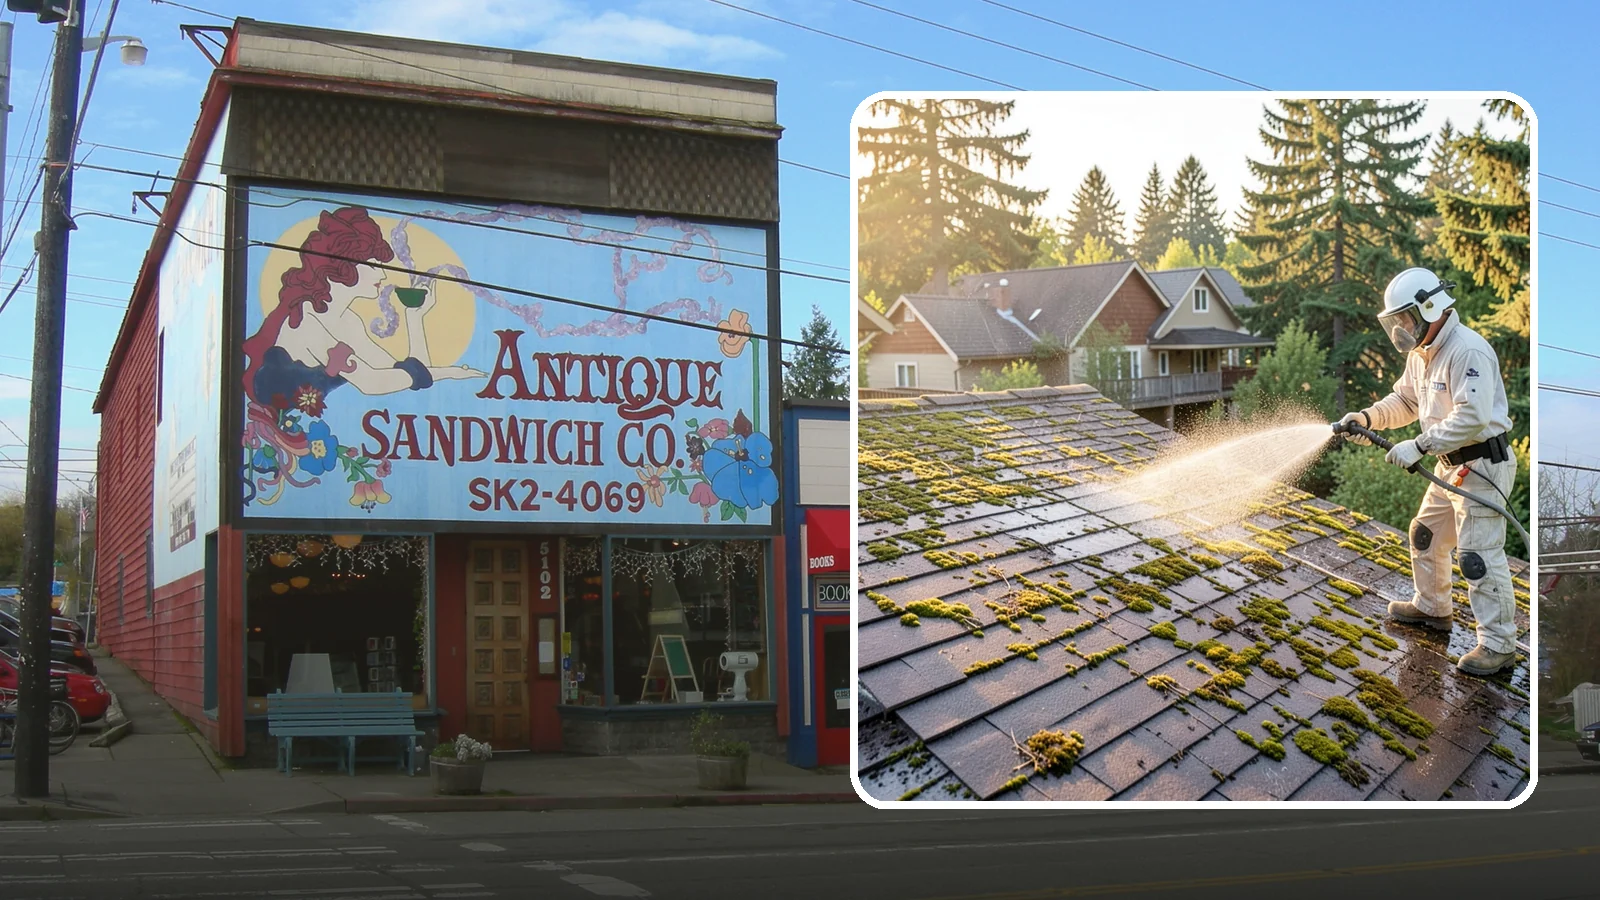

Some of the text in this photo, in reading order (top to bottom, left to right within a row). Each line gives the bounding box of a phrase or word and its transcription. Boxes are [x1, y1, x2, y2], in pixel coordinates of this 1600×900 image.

[475, 329, 724, 421] ANTIQUE
[361, 408, 686, 469] SANDWICH CO.
[468, 477, 646, 513] SK2-4069
[540, 542, 551, 599] 5102
[809, 555, 834, 569] BOOKS
